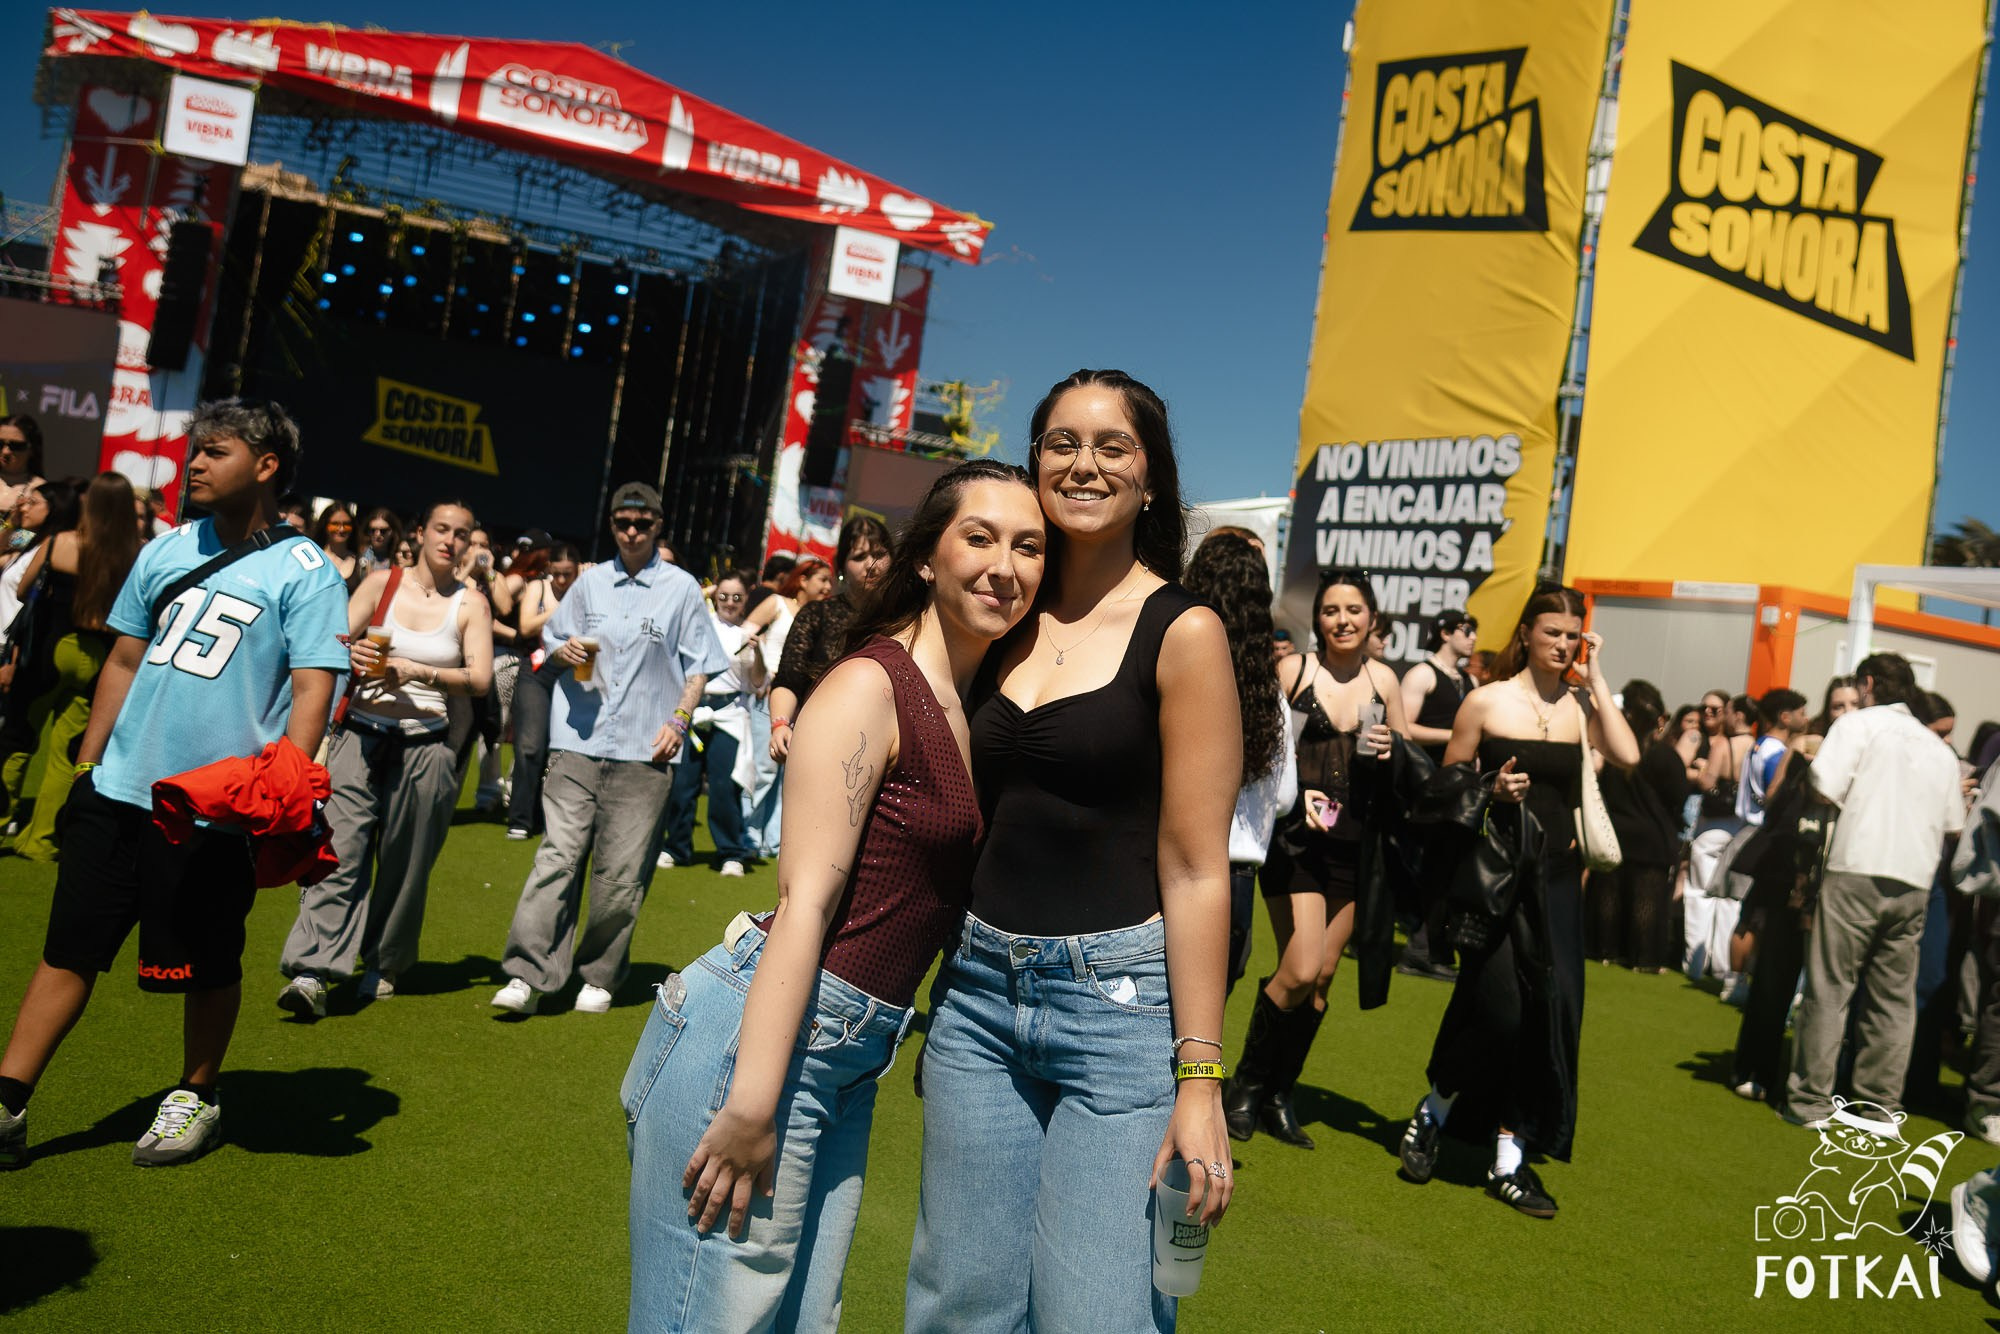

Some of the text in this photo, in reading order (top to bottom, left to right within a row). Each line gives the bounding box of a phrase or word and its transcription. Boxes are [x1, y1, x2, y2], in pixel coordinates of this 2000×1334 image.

[305, 43, 412, 99] VIBRA
[506, 69, 619, 110] COSTA
[187, 119, 234, 140] VIBRA
[500, 87, 643, 137] SONORA
[1378, 61, 1508, 168] COSTA
[707, 141, 800, 189] VIBRA
[1372, 108, 1532, 218] SONORA
[1678, 90, 1859, 212] COSTA
[1669, 203, 1890, 334] SONORA
[40, 384, 100, 421] FILA
[384, 388, 467, 422] COSTA
[381, 425, 483, 464] SONORA
[1316, 433, 1522, 481] NO VINIMOS
[1316, 482, 1513, 532] A ENCAJAR,
[1316, 529, 1494, 572] VINIMOS A
[1180, 1065, 1214, 1076] GENERAL
